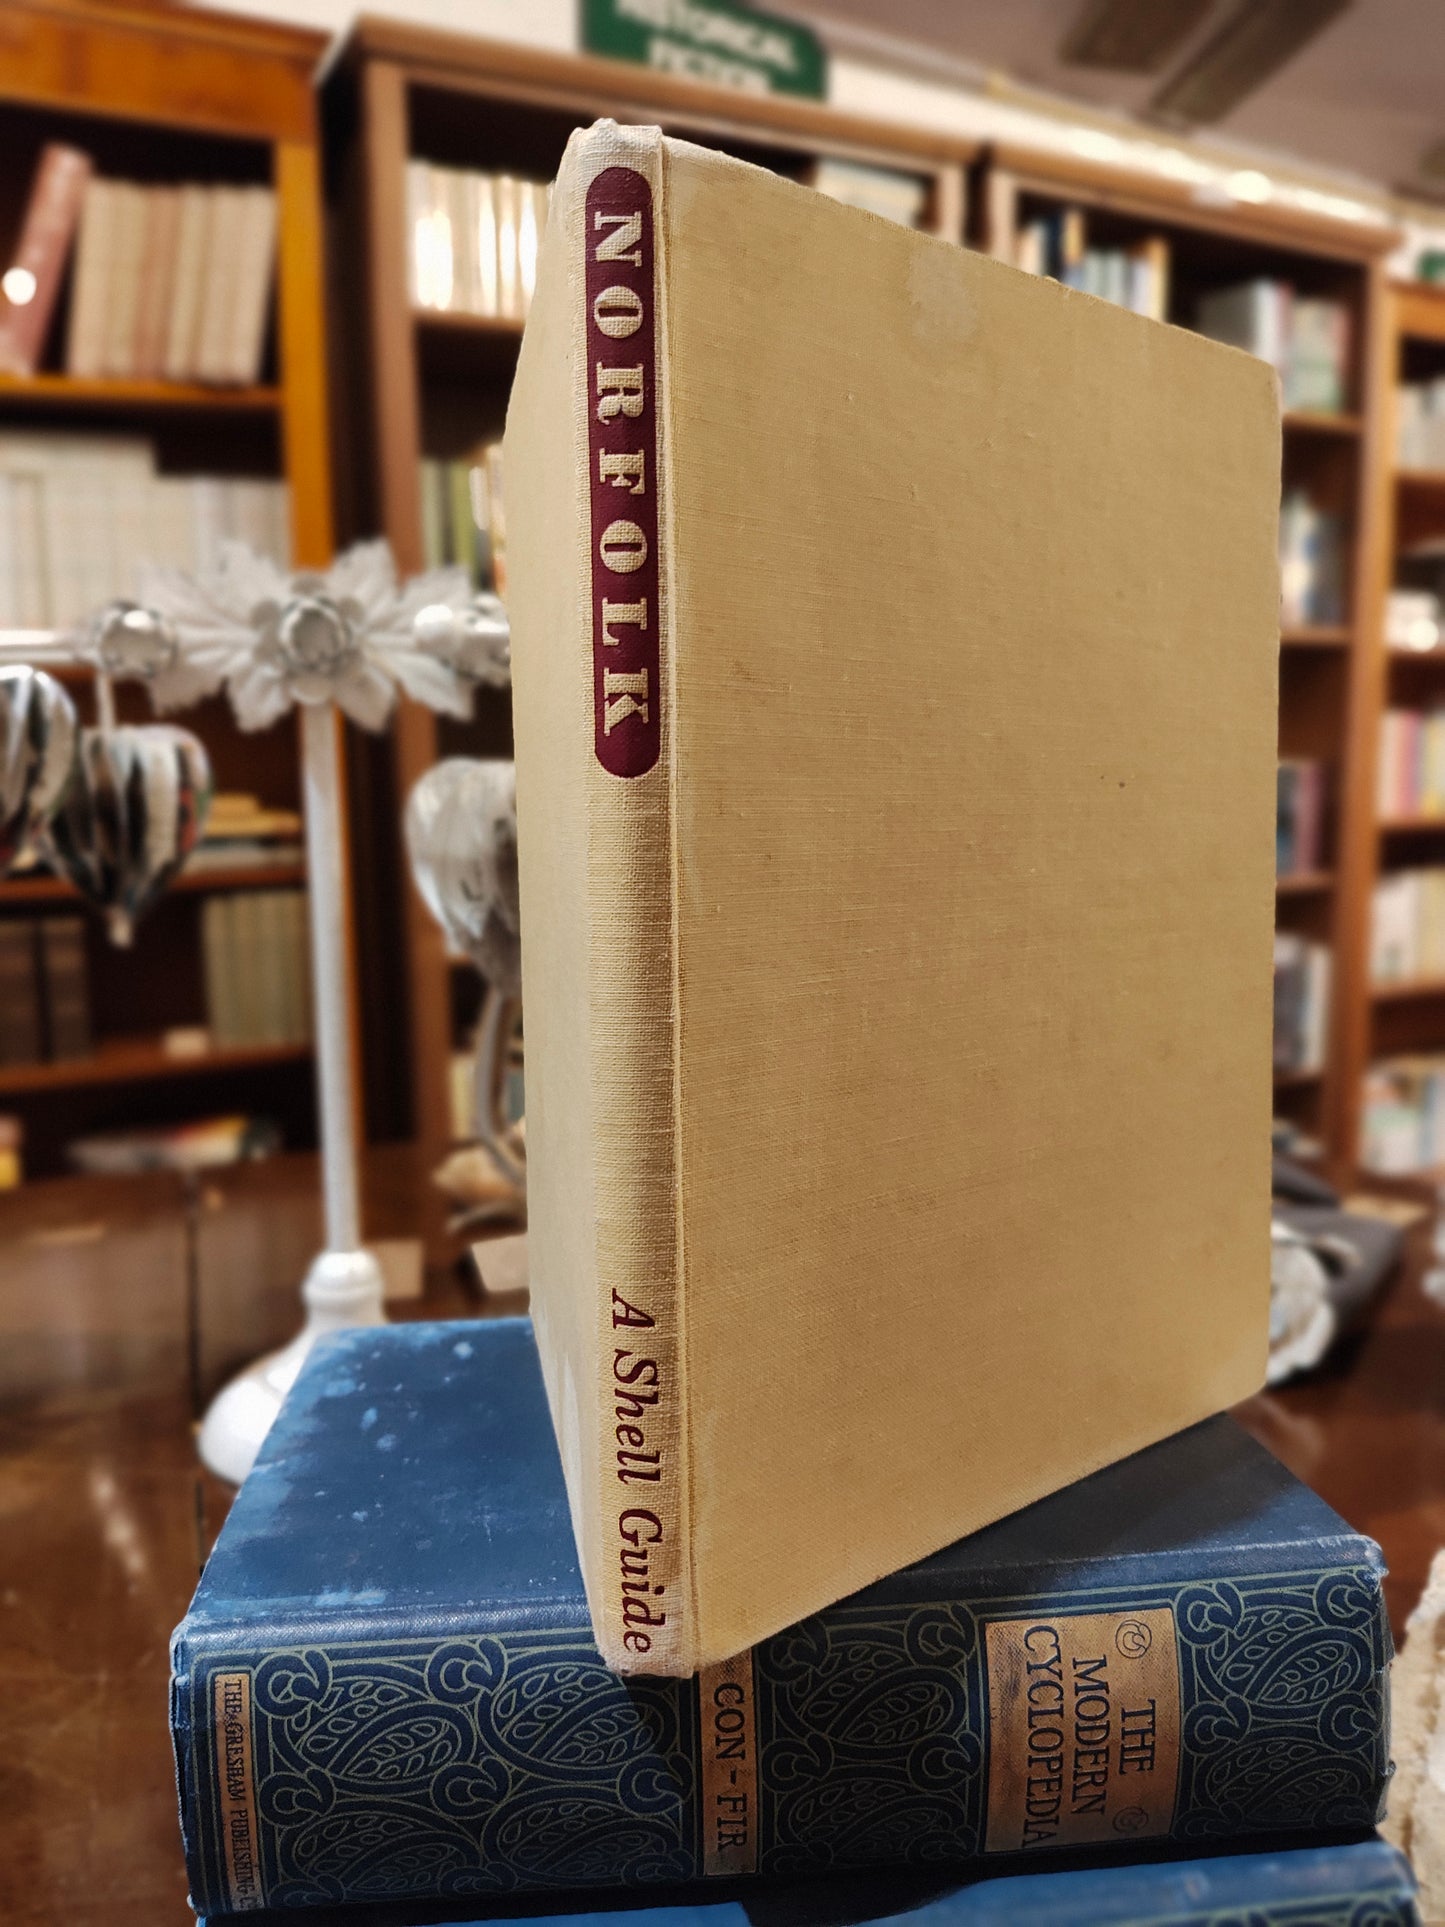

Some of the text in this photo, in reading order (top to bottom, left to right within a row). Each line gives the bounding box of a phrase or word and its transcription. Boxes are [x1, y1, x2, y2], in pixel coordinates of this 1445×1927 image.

[594, 211, 648, 736] NORFOLK
[612, 1288, 666, 1654] A Shell Guide
[224, 1680, 242, 1713] THE
[1021, 1625, 1064, 1848] CYCLOPEDIA
[1071, 1654, 1111, 1816] MODERN
[1119, 1699, 1156, 1775] THE
[224, 1720, 246, 1802] GRESHAM
[230, 1808, 255, 1892] PUBLISHING
